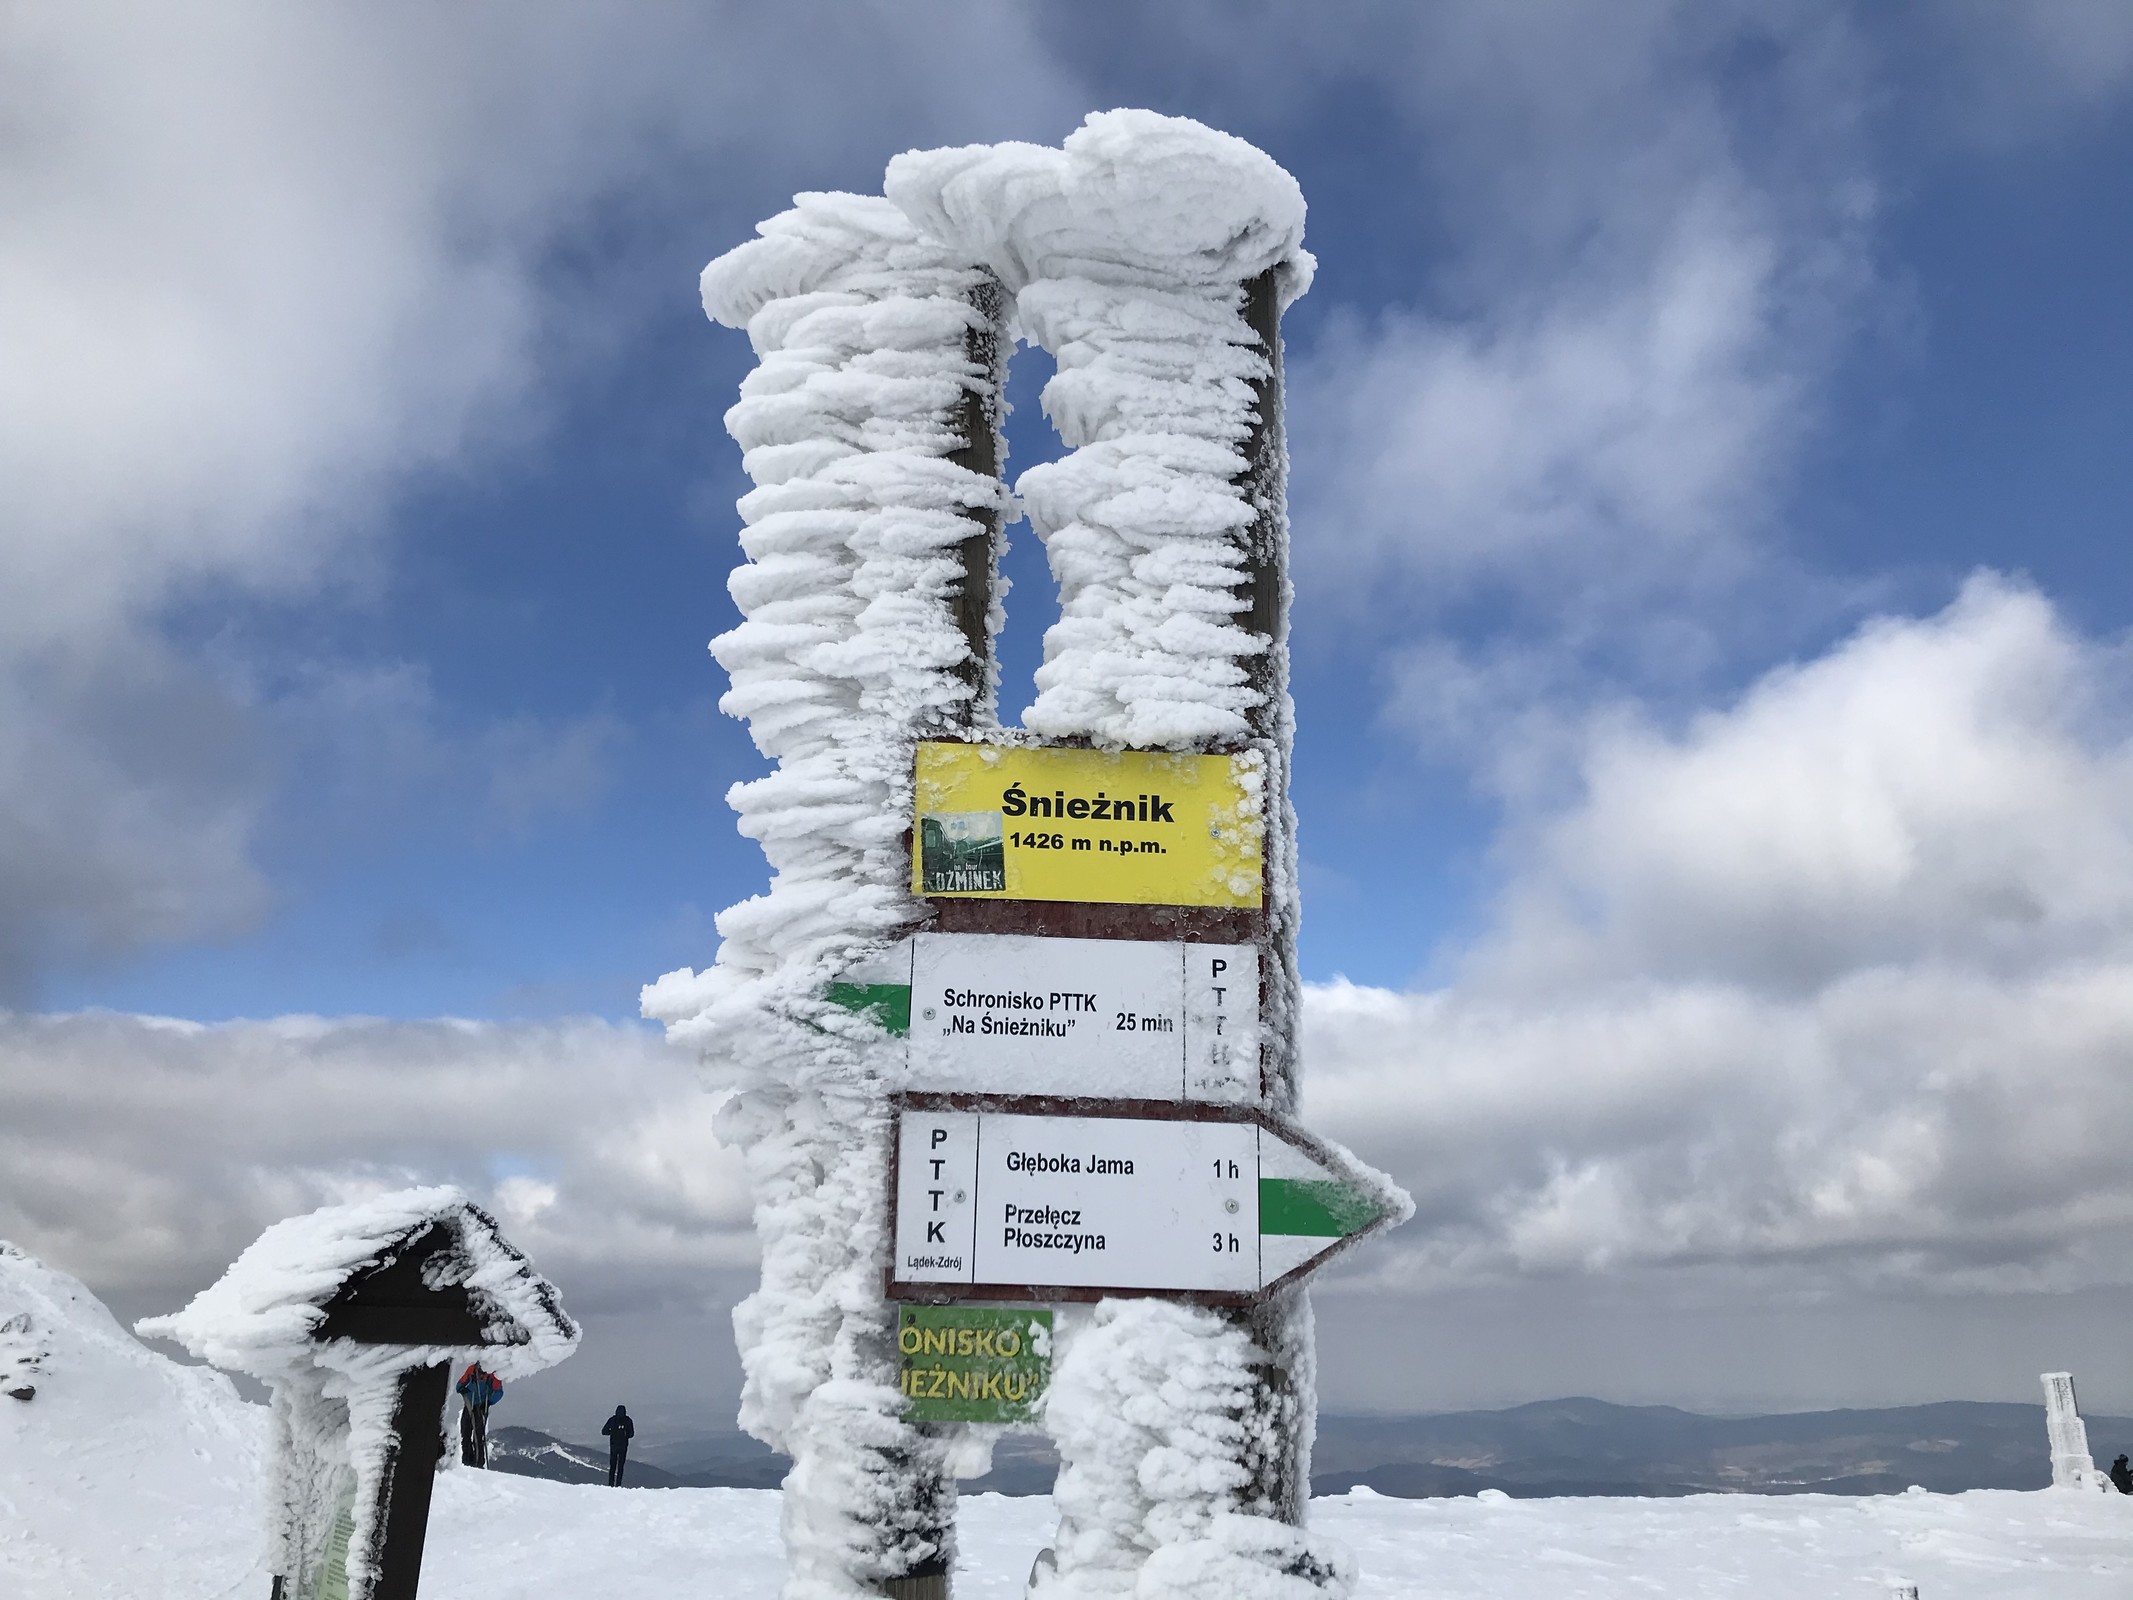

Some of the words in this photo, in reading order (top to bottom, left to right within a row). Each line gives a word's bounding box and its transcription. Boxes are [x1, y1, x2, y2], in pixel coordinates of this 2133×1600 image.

[1001, 781, 1176, 823] Śnieżnik
[1009, 832, 1064, 850] 1426
[1071, 838, 1091, 851] m
[1099, 839, 1167, 856] n.p.m.
[943, 988, 1044, 1010] Schronisko
[1049, 992, 1098, 1012] PTTK
[1116, 1012, 1137, 1031] 25
[1141, 1013, 1173, 1032] min
[1006, 1152, 1081, 1176] Głęboka
[1086, 1154, 1135, 1175] Jama
[1213, 1159, 1221, 1178] 1
[1228, 1160, 1239, 1179] h
[927, 1128, 948, 1243] PTTK
[1004, 1203, 1081, 1229] Przełęcz
[1004, 1227, 1106, 1254] Płoszczyna
[1212, 1233, 1223, 1252] 3
[1228, 1233, 1240, 1252] h
[907, 1256, 962, 1271] Lądek-Zdrój
[898, 1326, 1021, 1357] ONISKO
